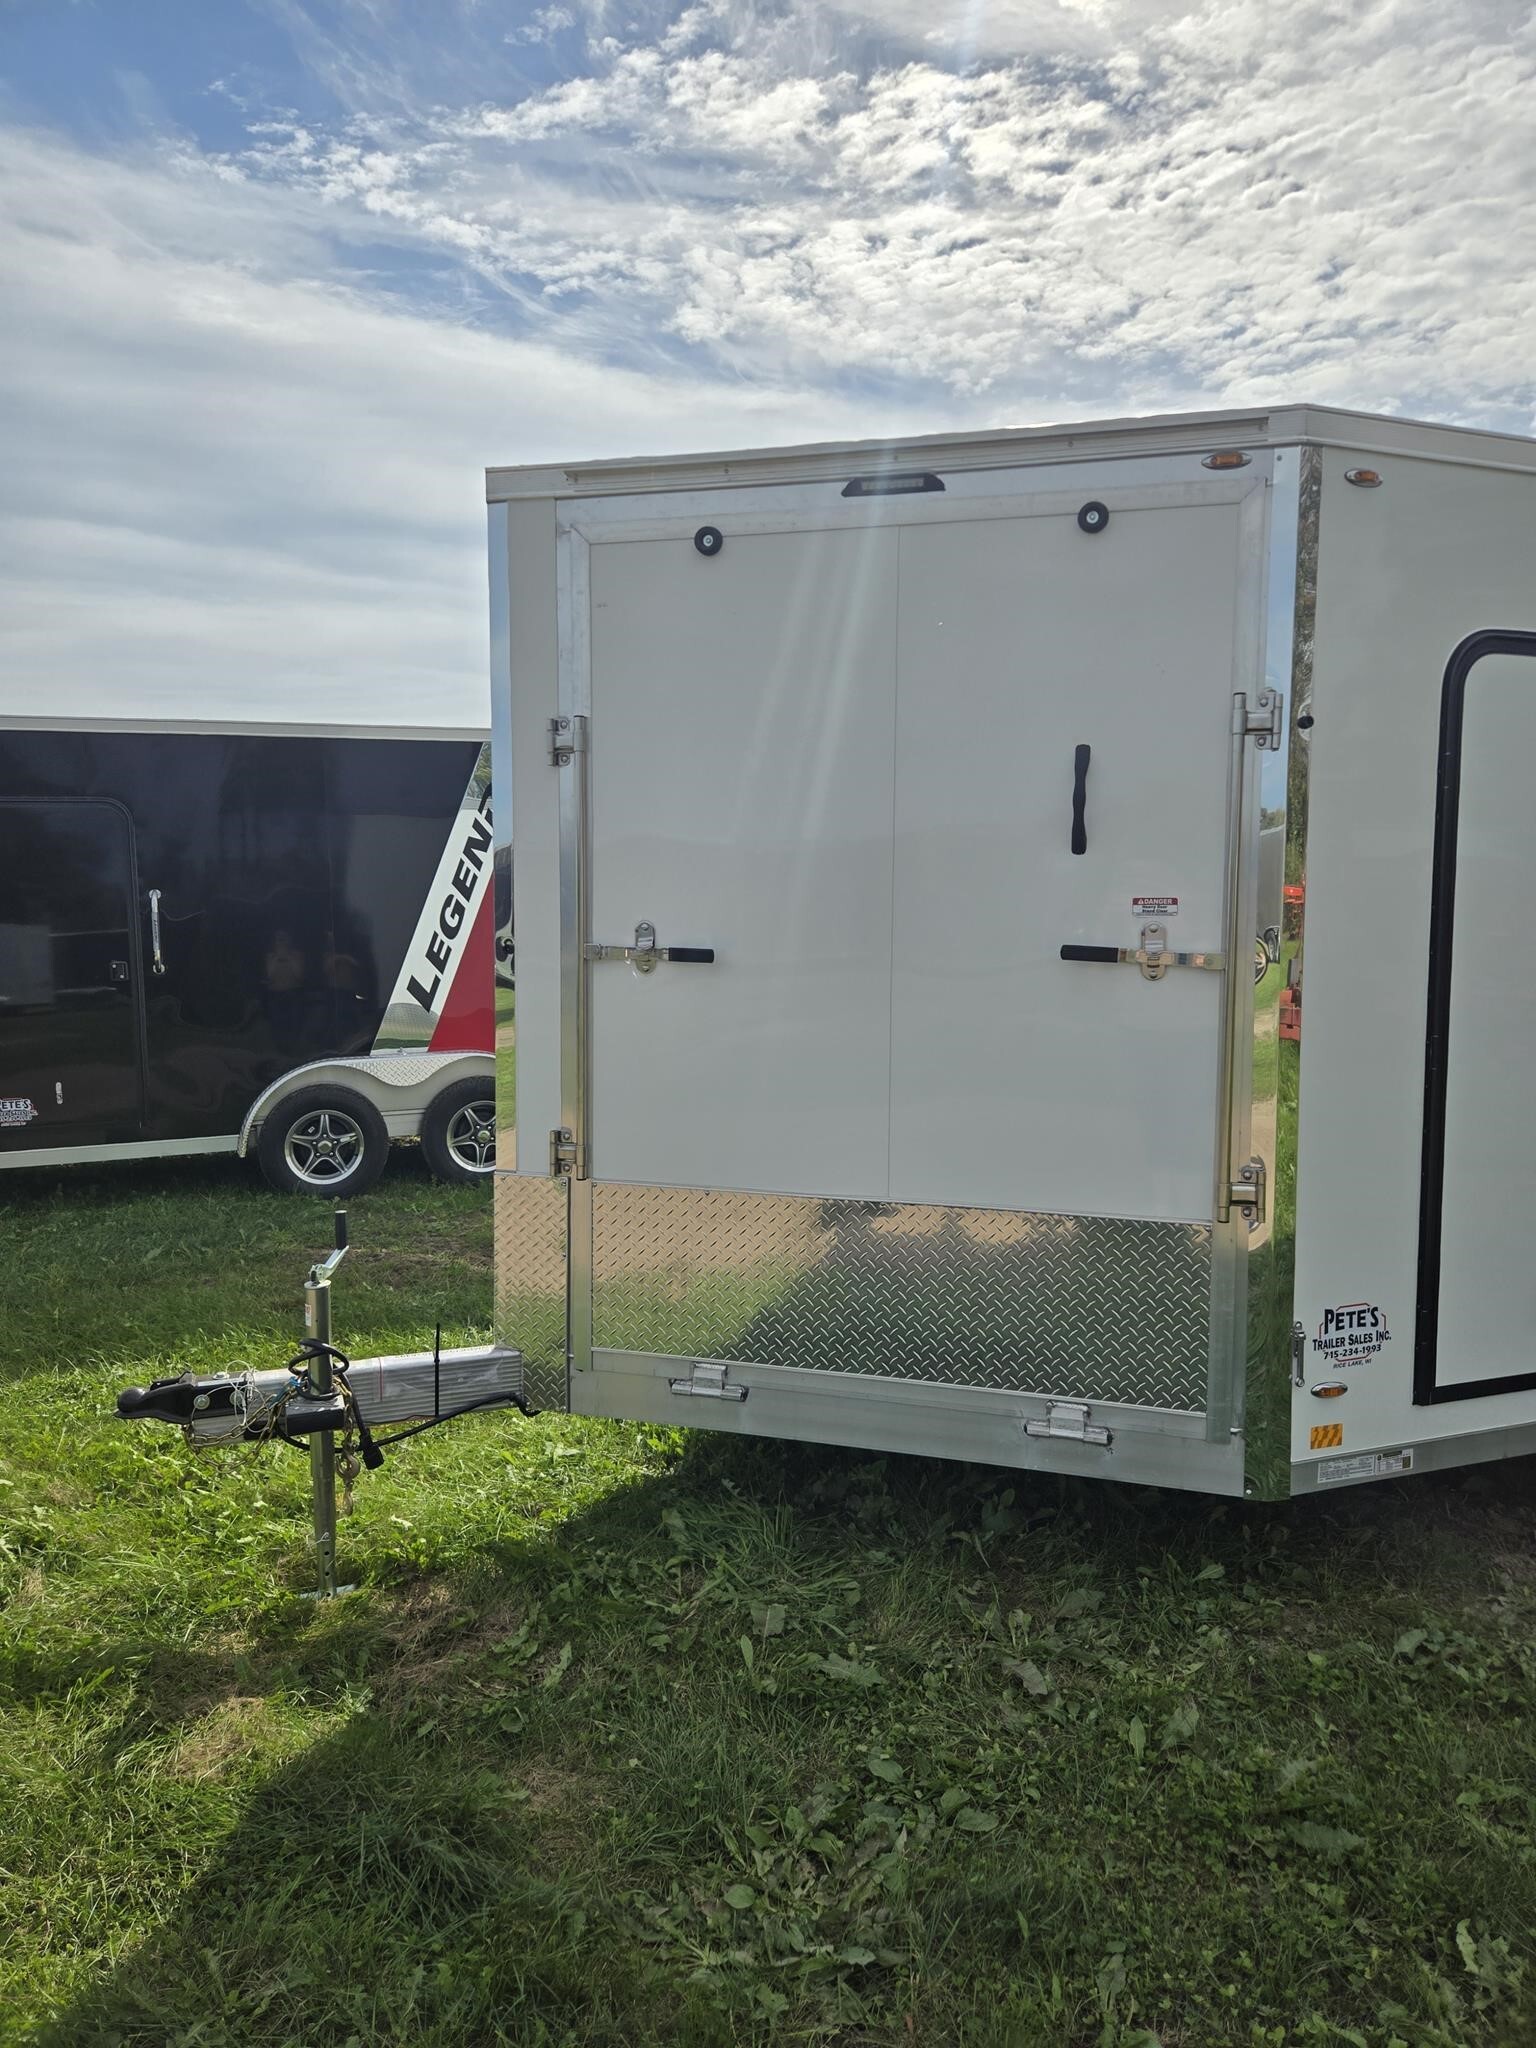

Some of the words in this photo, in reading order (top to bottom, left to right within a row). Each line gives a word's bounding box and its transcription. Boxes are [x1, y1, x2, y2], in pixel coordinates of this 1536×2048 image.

[1324, 1306, 1379, 1335] PETE'S
[1312, 1337, 1346, 1351] TRAILER
[1348, 1333, 1373, 1346] SALES
[1375, 1330, 1392, 1342] INC.
[1323, 1344, 1382, 1360] 715-234-1993
